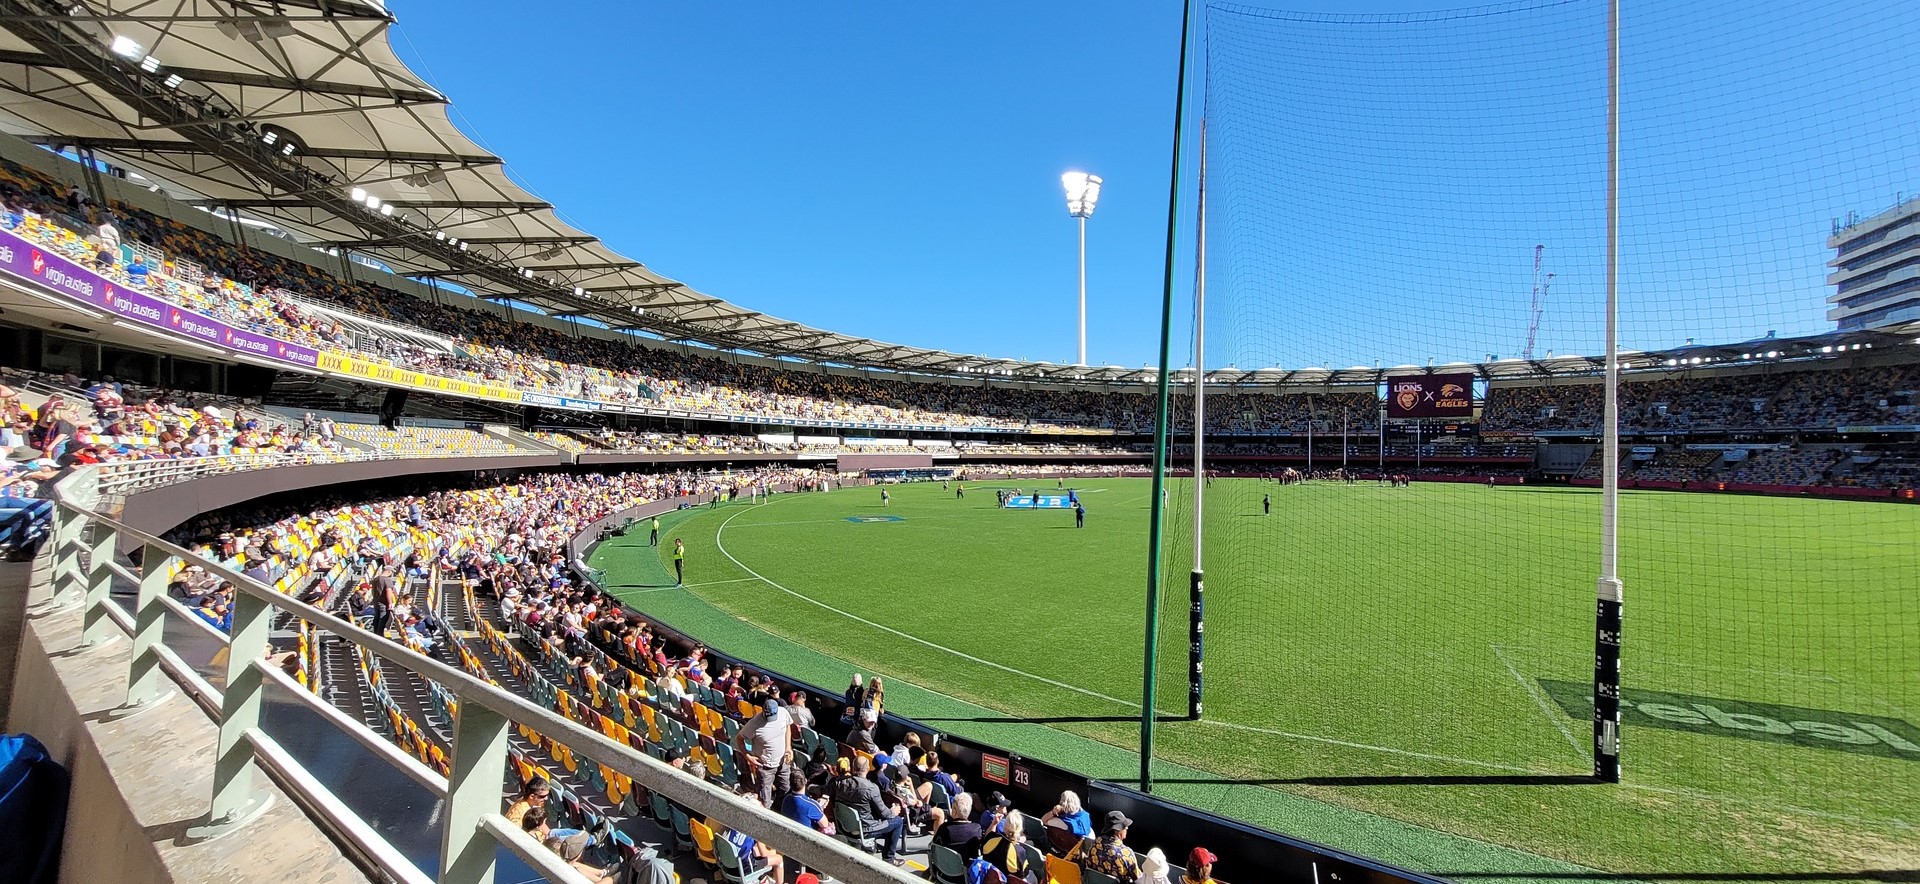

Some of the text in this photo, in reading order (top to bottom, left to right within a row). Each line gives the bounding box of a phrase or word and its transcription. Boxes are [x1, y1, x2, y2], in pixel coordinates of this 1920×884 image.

[45, 266, 93, 296] virgin australia
[114, 296, 160, 320] virgin australia
[182, 320, 217, 338] virgin australia
[233, 336, 268, 352] virgin australia
[286, 350, 315, 364] virgin australia
[322, 356, 342, 370] XXXX
[351, 362, 369, 376] XXXX
[377, 367, 394, 380] XXXX
[400, 373, 416, 384] XXXX
[425, 376, 439, 387] XXXX
[1585, 696, 1920, 751] ebel
[1015, 769, 1028, 785] 213
